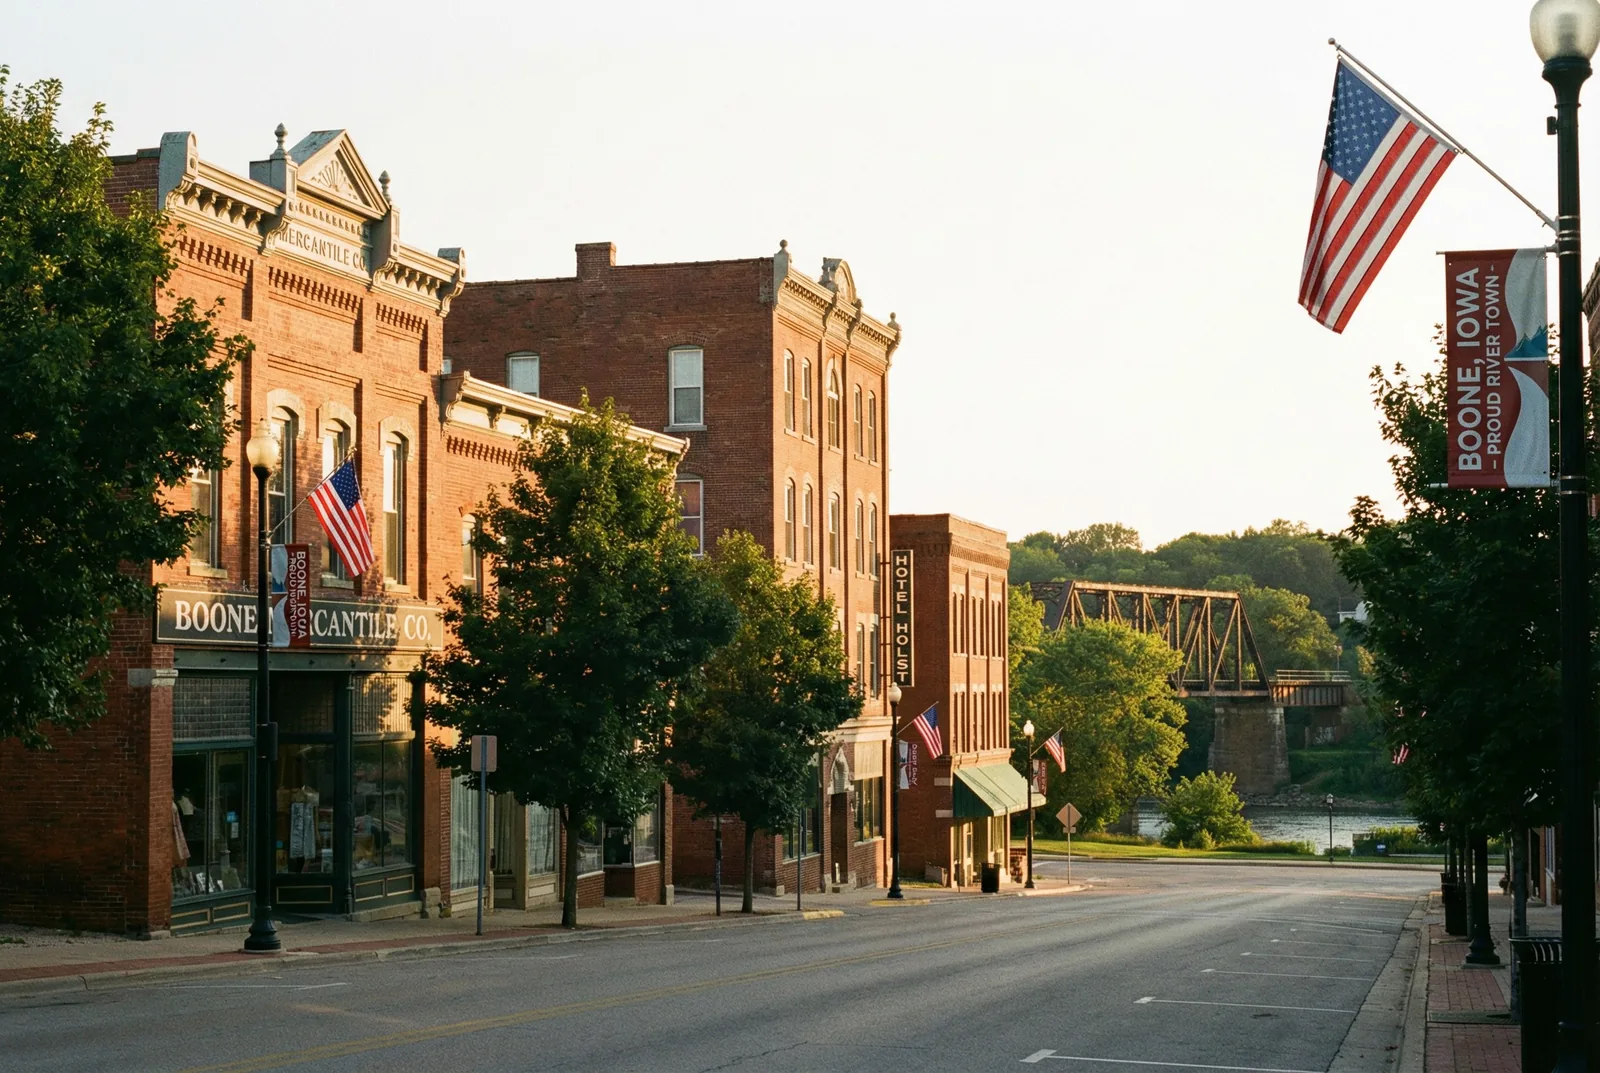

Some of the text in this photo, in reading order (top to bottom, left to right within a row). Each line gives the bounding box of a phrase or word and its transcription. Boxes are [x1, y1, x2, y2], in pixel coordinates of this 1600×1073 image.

[1485, 275, 1500, 328] TOWN
[1456, 267, 1486, 471] BOONE, IOWA
[1486, 334, 1501, 389] RIVER
[1486, 391, 1502, 455] PROUD
[174, 600, 432, 640] BOONE CANTILE CO.
[895, 555, 909, 682] HOTEL HOLST
